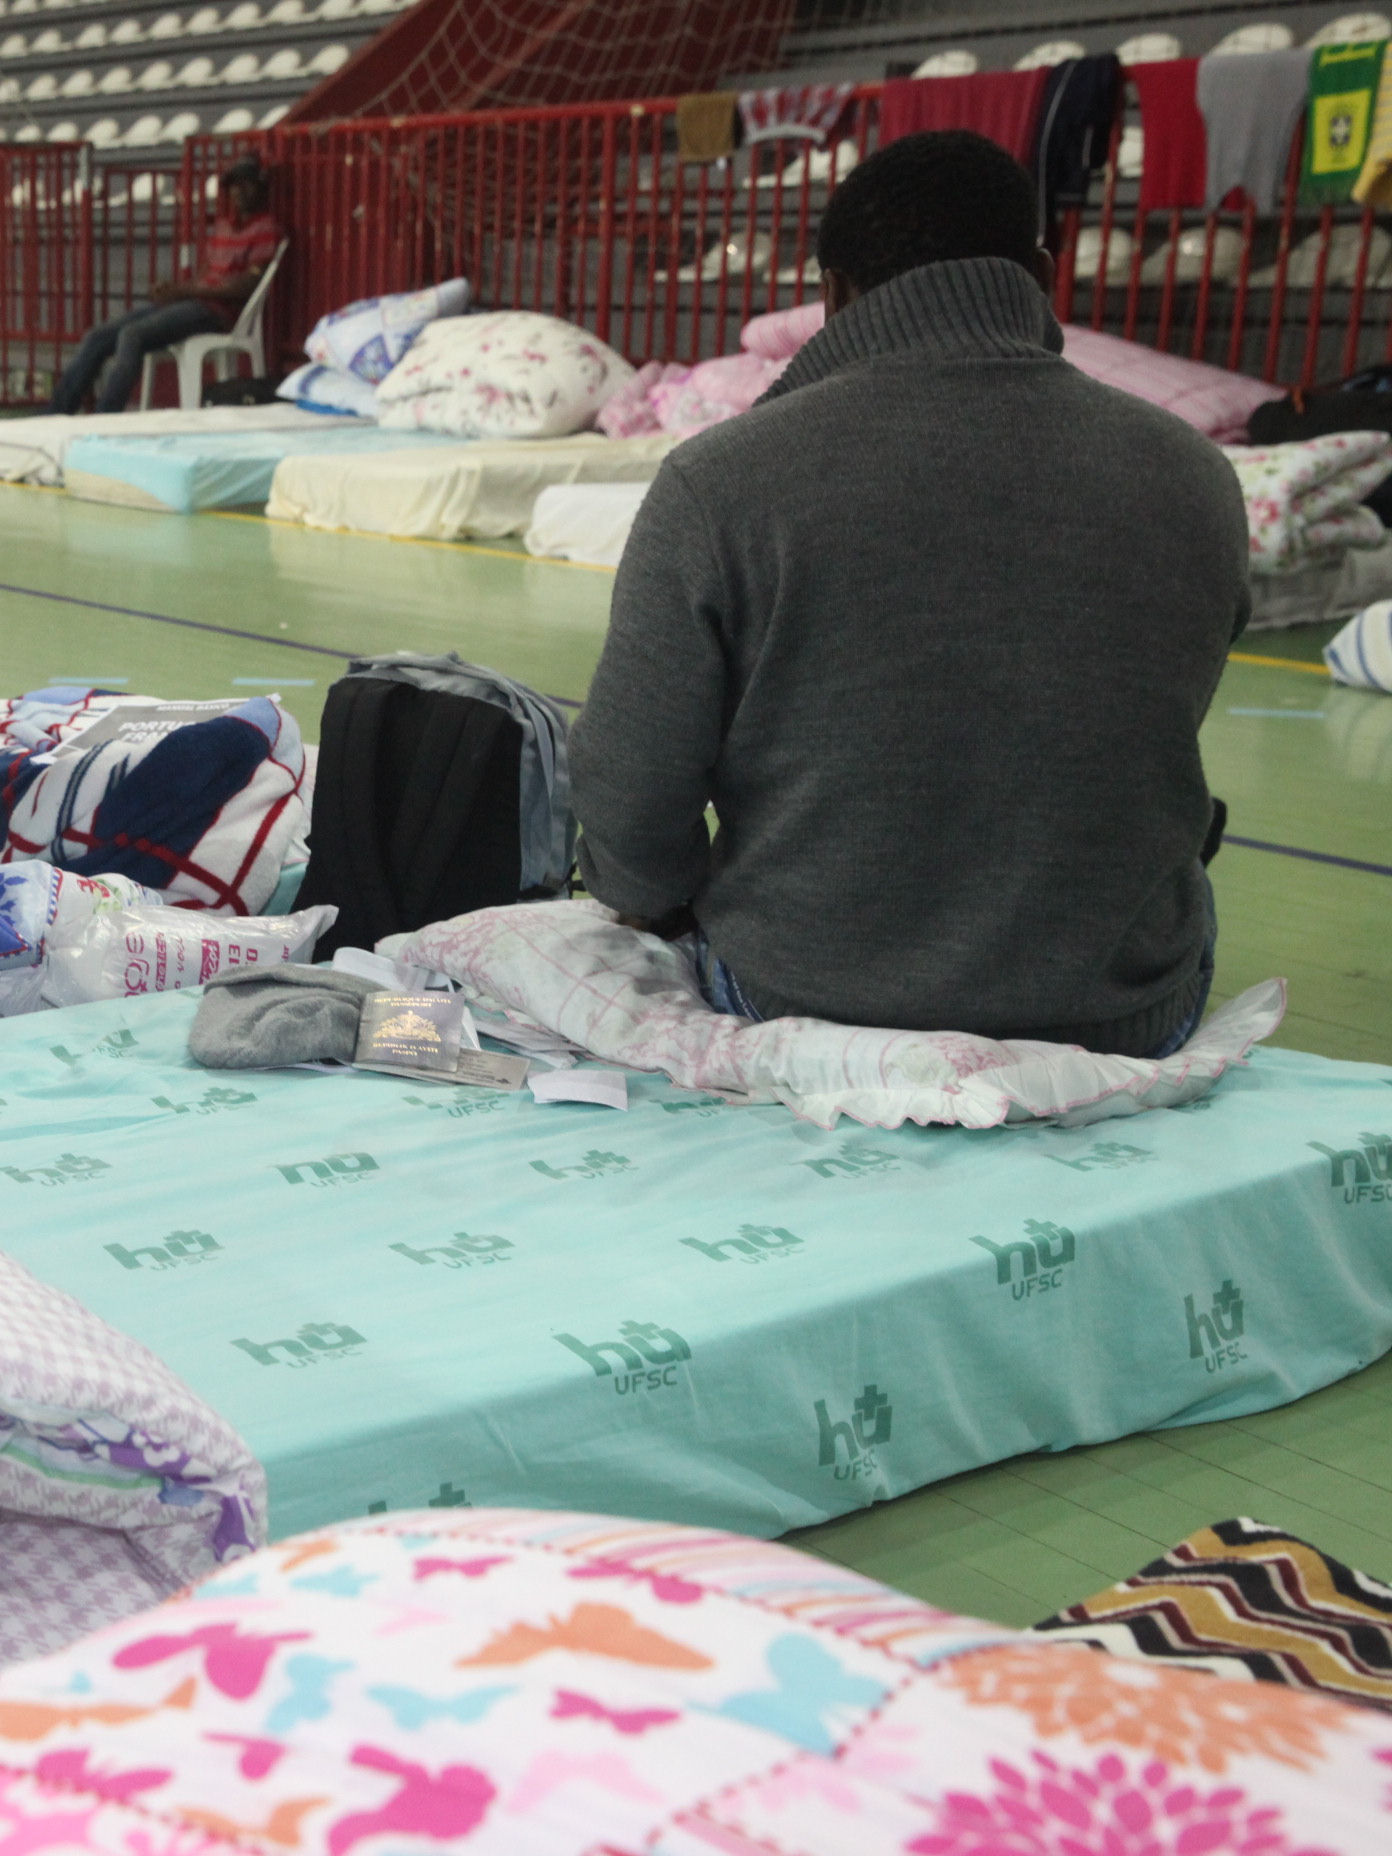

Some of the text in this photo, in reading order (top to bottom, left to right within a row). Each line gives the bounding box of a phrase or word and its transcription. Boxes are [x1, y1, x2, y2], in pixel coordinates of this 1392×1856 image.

[118, 721, 196, 732] PORTU
[447, 1100, 505, 1118] UFSC
[310, 1171, 376, 1188] UFSC
[103, 1230, 225, 1270] hu
[678, 1223, 804, 1262] hu
[969, 1218, 1075, 1285] hu
[1012, 1269, 1064, 1300] UFSC
[1184, 1280, 1244, 1359] hu
[230, 1322, 368, 1365] hu
[552, 1320, 692, 1376] hu
[1205, 1343, 1248, 1373] UFSC
[614, 1366, 678, 1395] UFSC
[813, 1384, 892, 1467] hu
